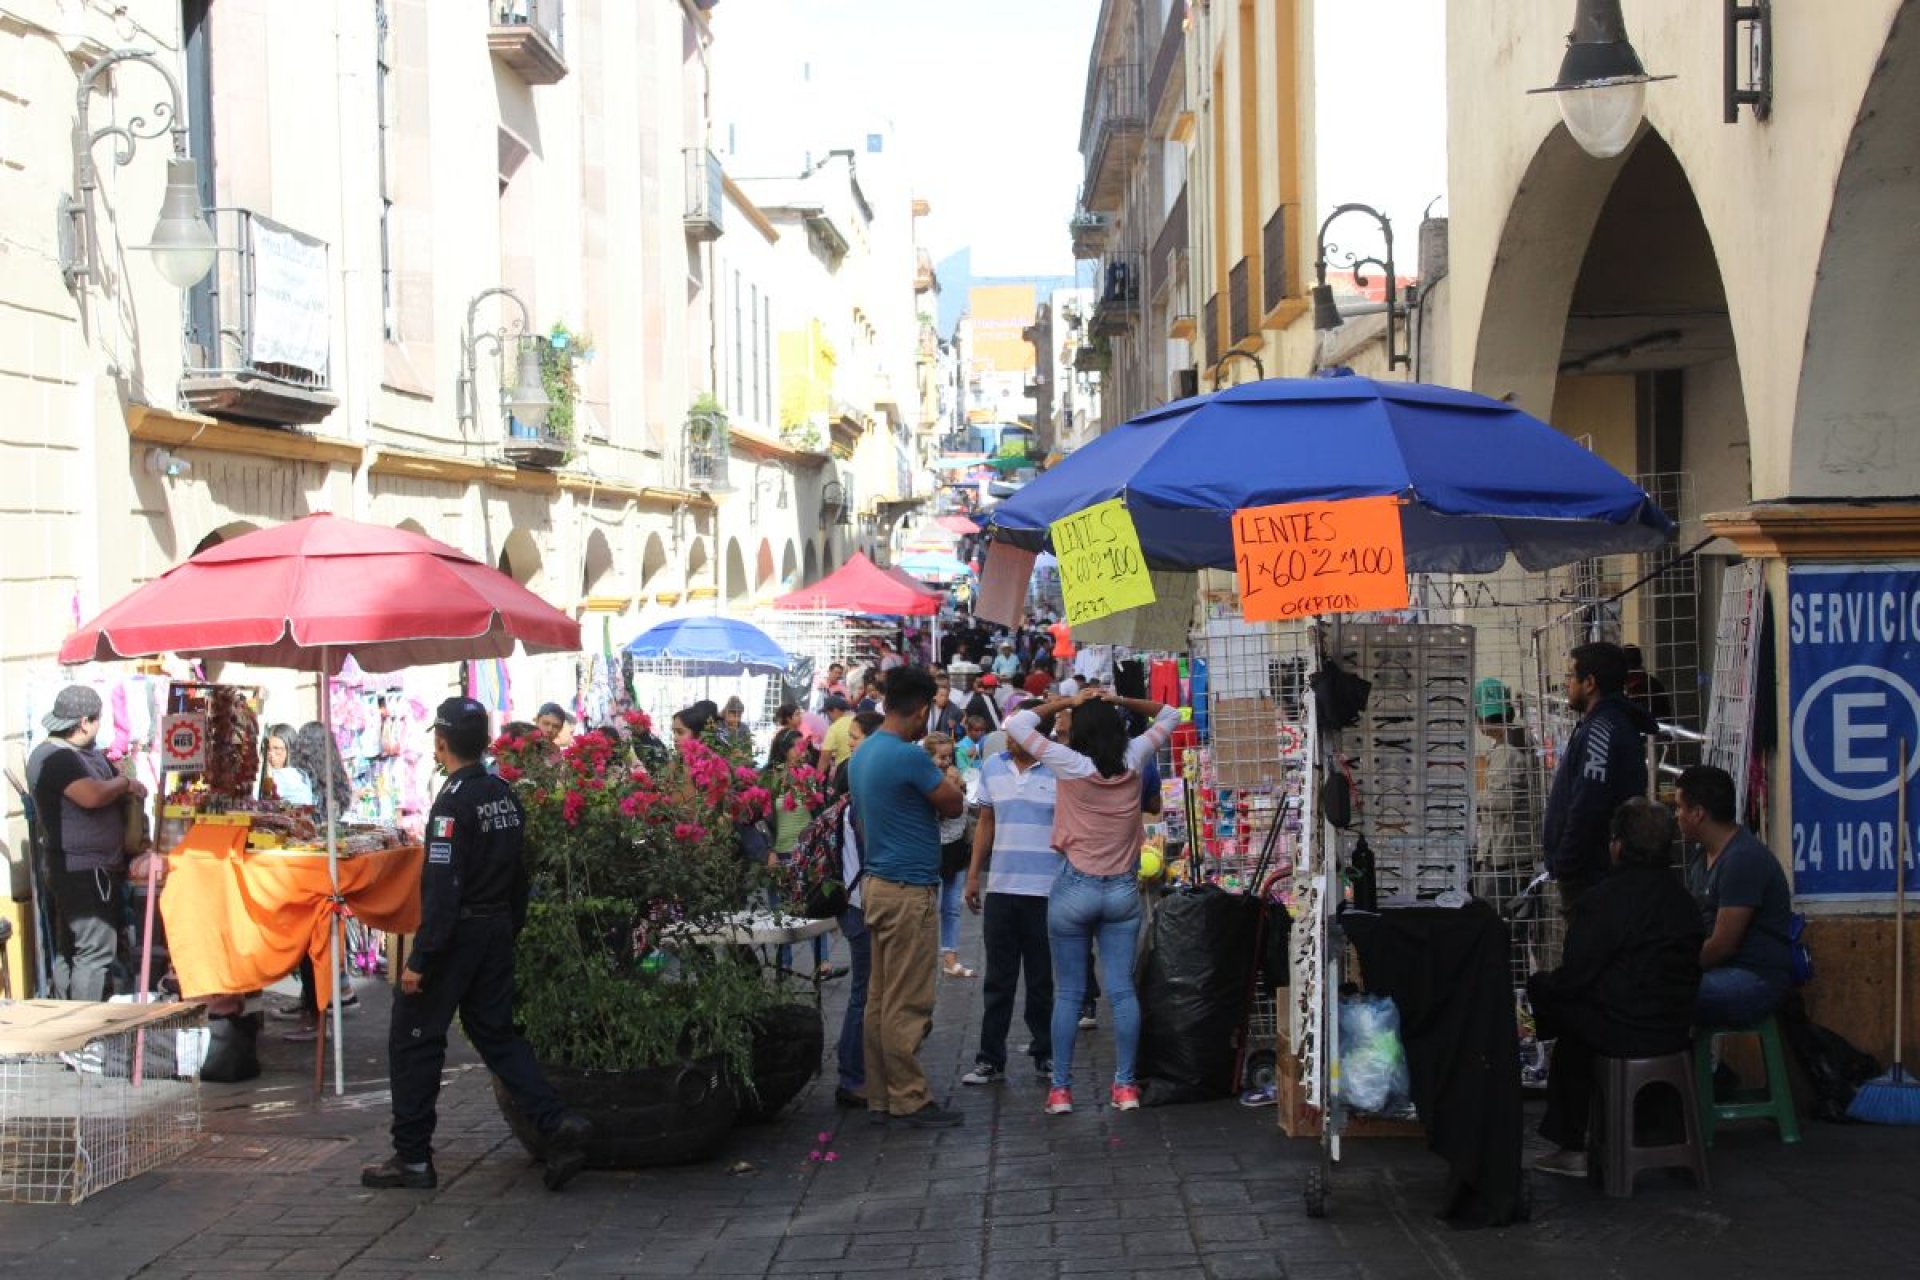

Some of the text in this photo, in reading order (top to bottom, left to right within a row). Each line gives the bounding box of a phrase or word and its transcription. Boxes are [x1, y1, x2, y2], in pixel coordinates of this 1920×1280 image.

[1240, 511, 1337, 545] LENTES
[1832, 692, 1889, 775] E
[1793, 819, 1920, 872] 24 HORA
